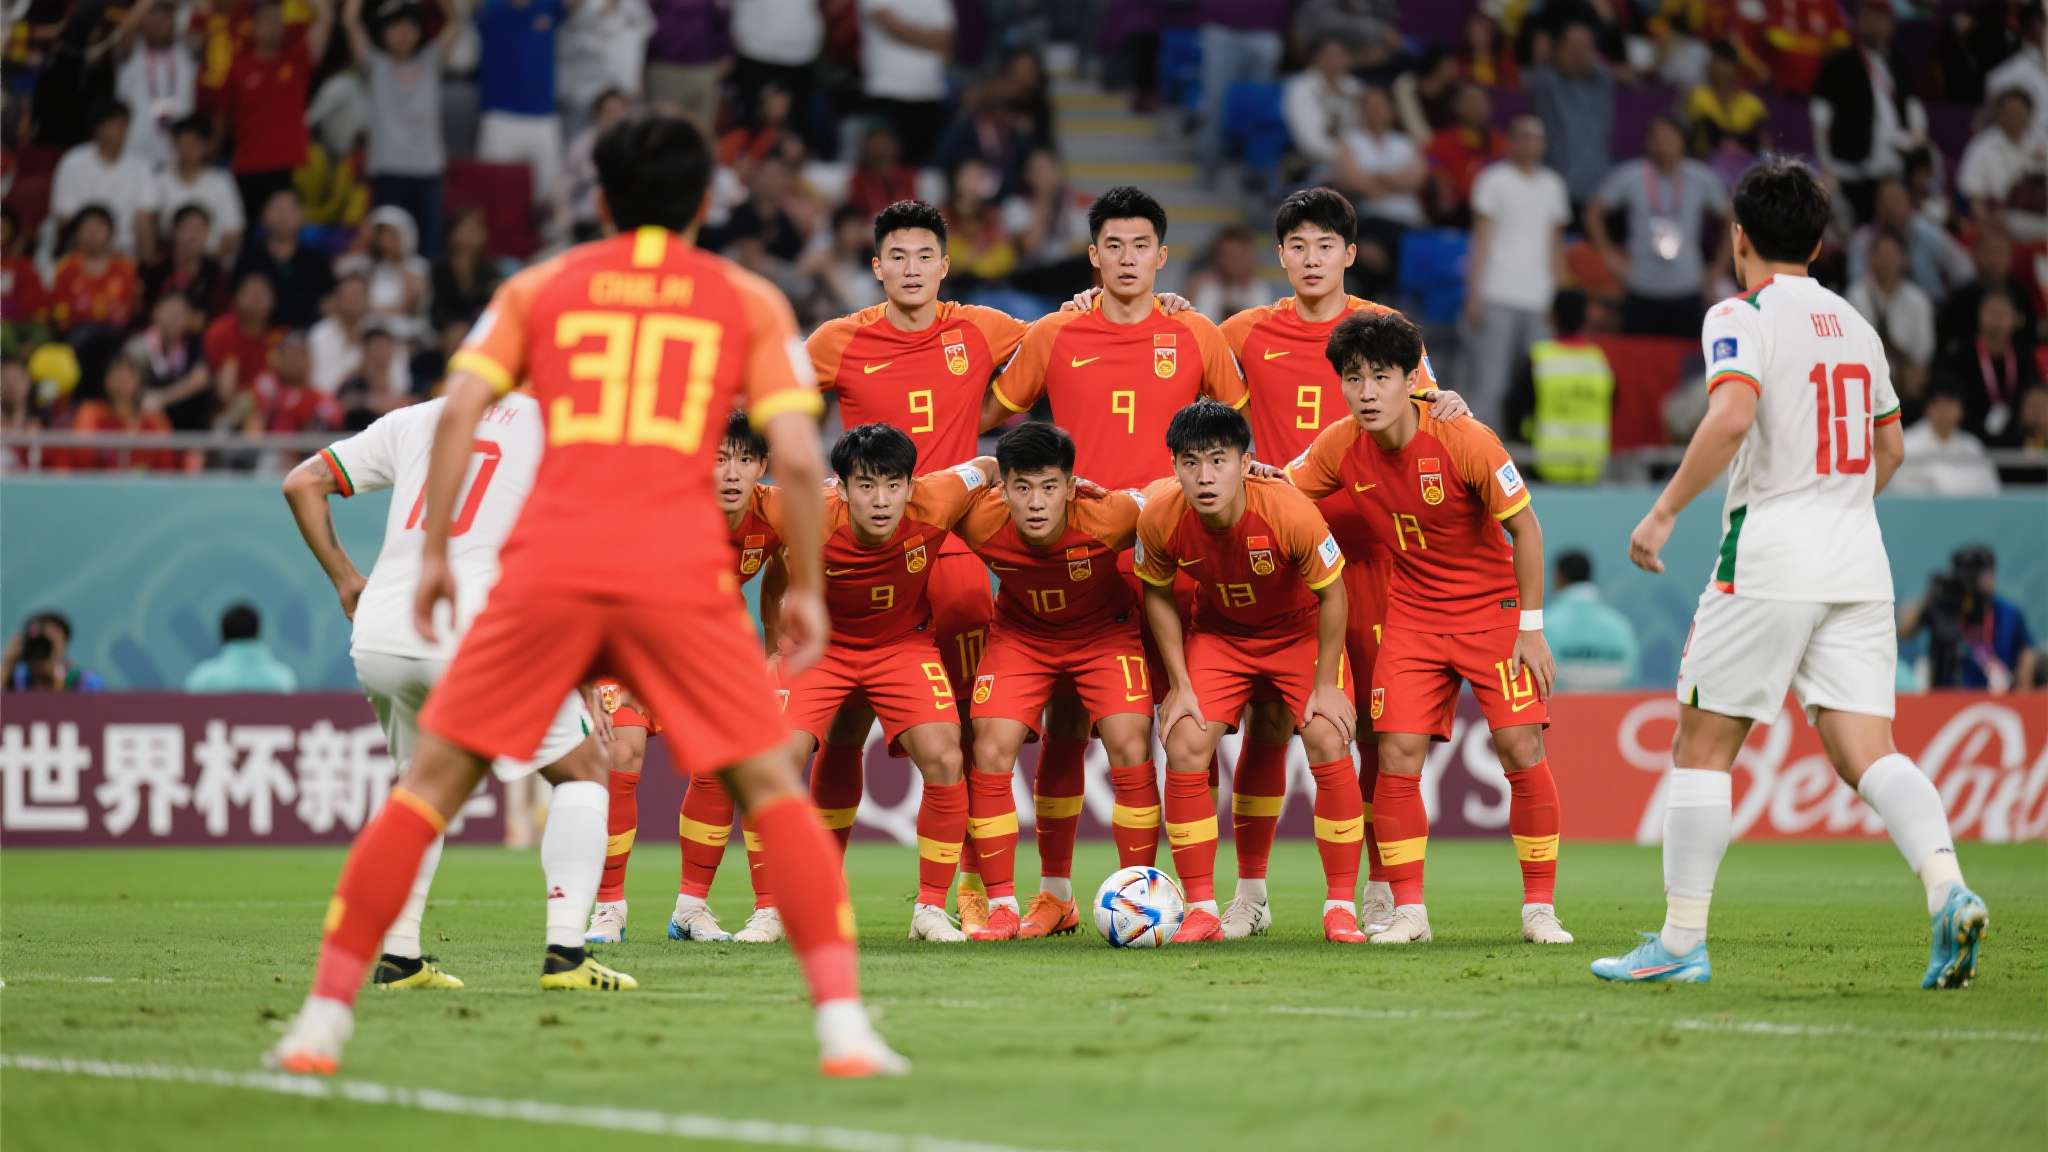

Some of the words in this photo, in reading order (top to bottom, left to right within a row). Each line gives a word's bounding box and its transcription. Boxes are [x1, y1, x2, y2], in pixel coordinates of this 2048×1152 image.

[549, 311, 722, 454] 30
[908, 389, 934, 434] 9
[1111, 390, 1136, 434] 9
[1296, 385, 1322, 429] 9
[1809, 362, 1871, 475] 10
[871, 585, 895, 609] 9
[1026, 589, 1066, 615] 10
[1215, 583, 1257, 608] 13
[920, 662, 952, 697] 9
[1115, 655, 1147, 690] 17
[0, 719, 497, 836] 世界杯新
